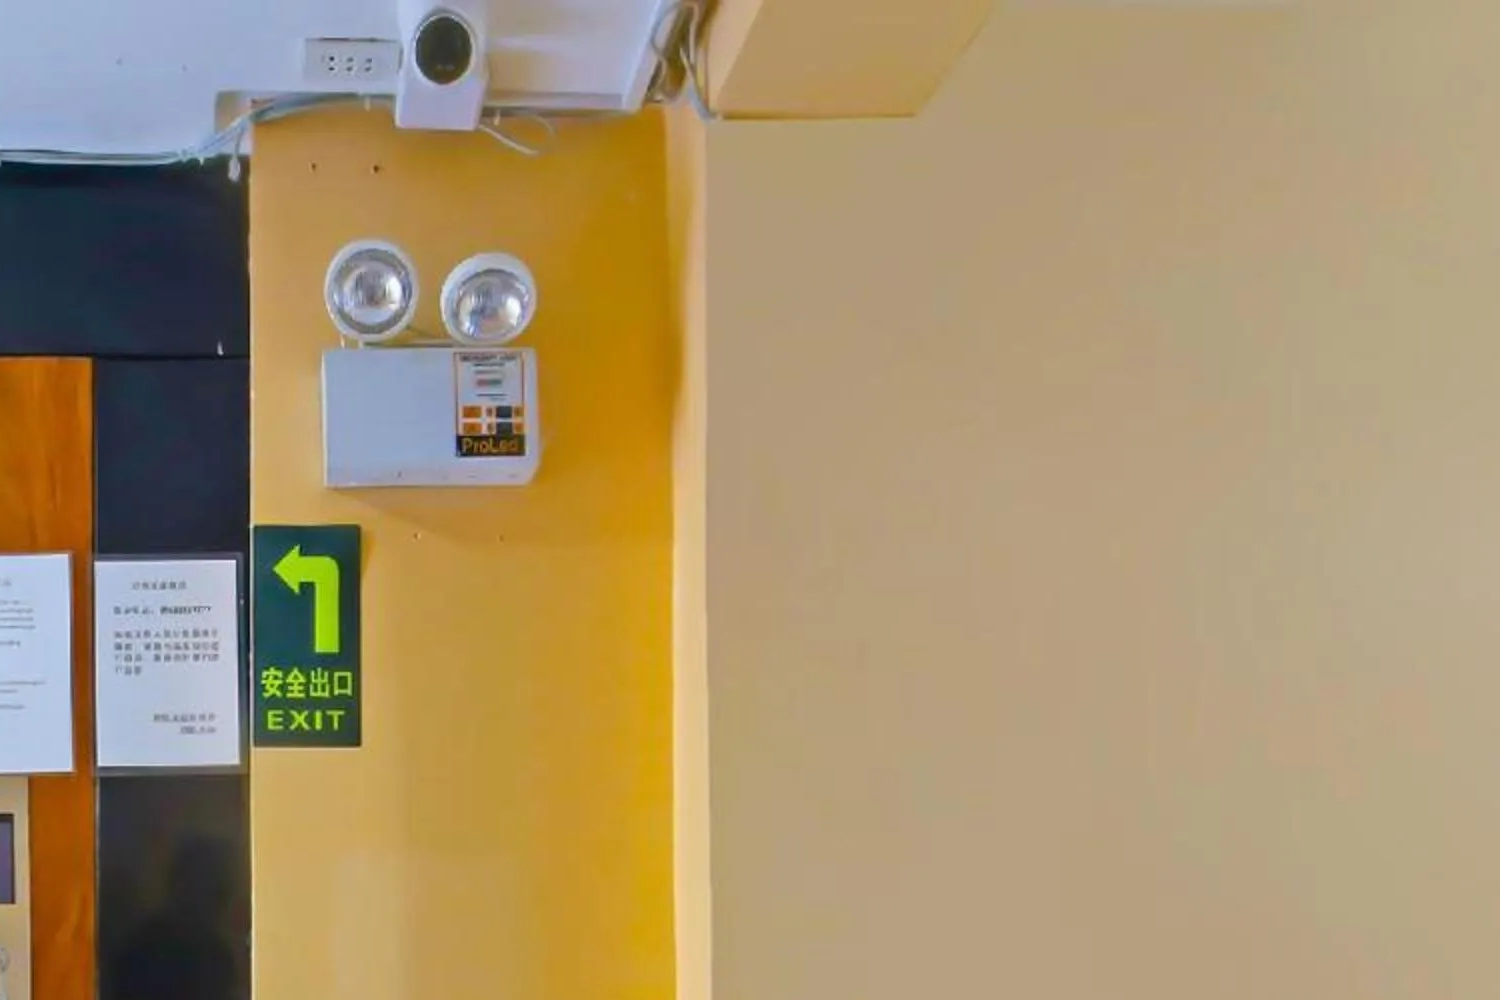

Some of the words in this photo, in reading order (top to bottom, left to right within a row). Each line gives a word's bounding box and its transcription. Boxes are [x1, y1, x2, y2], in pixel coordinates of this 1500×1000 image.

[261, 667, 353, 698] 安全出口
[267, 710, 345, 731] EXIT
